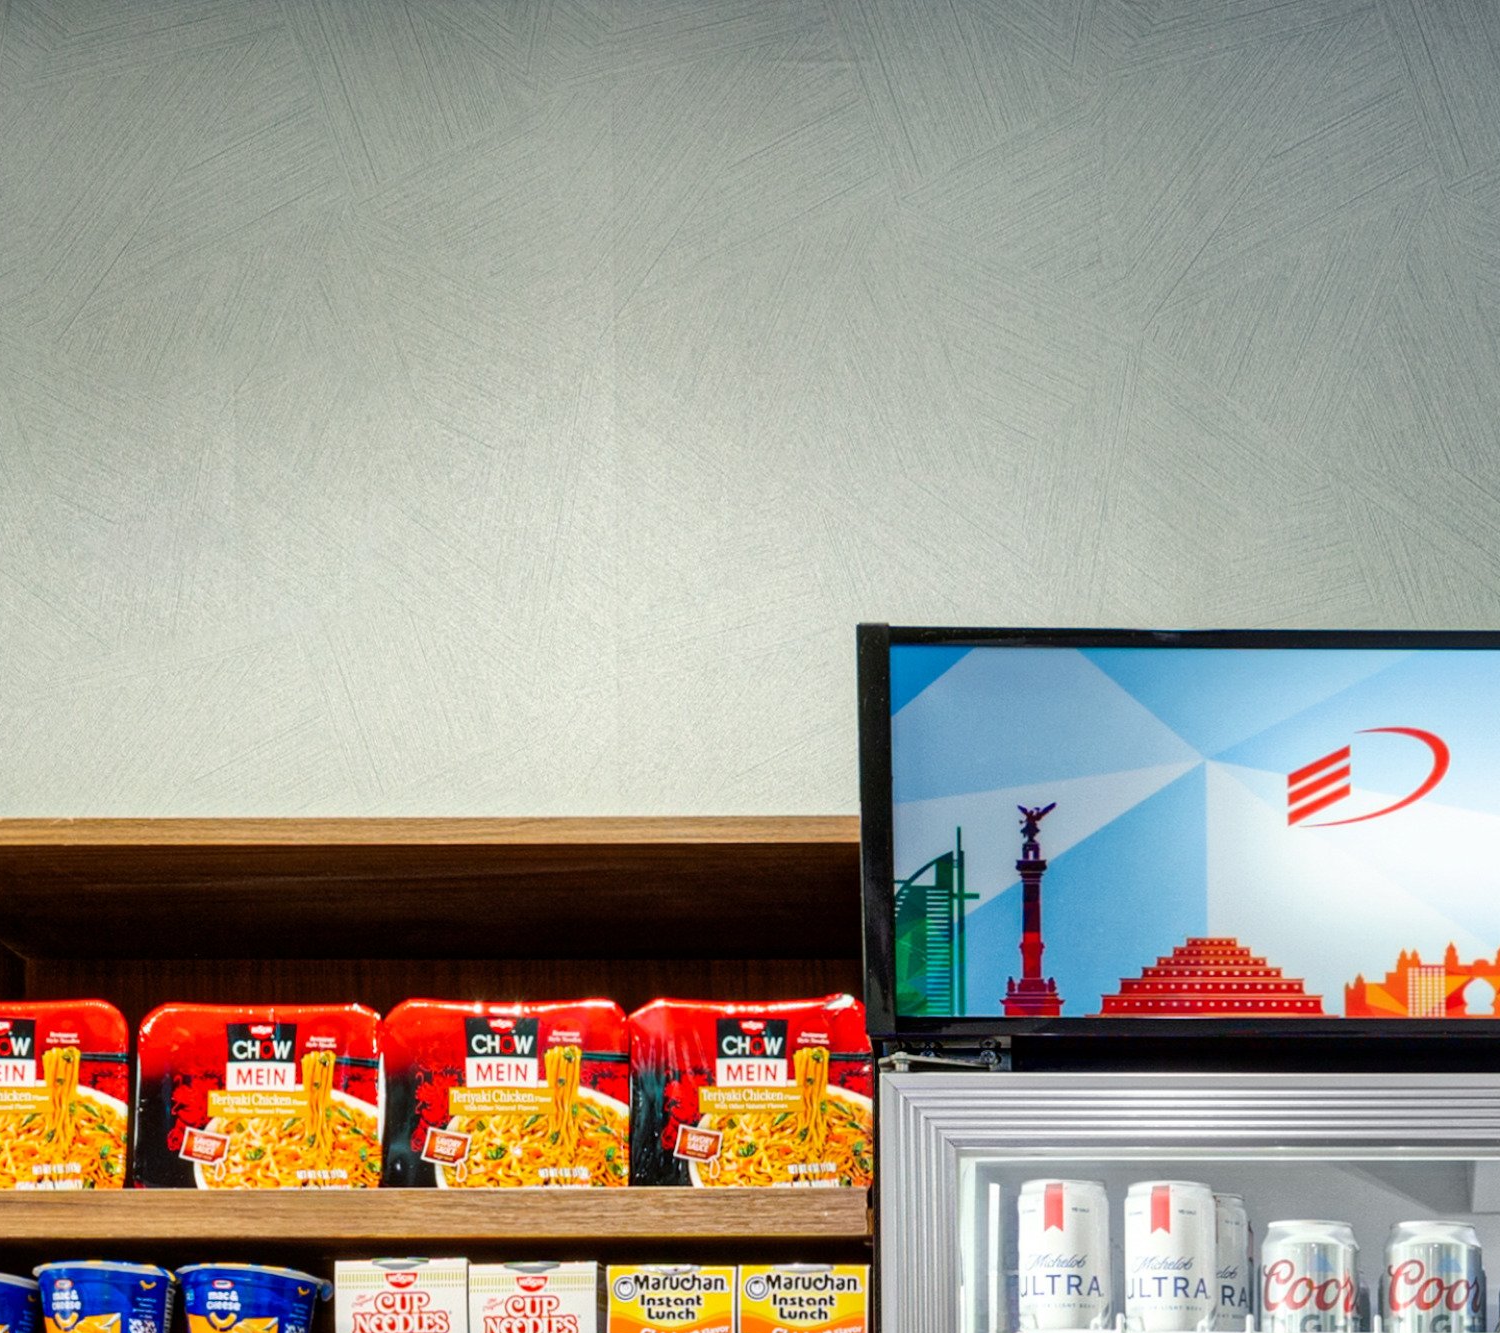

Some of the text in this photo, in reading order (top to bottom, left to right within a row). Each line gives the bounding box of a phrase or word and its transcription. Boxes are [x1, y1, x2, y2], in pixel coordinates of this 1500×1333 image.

[471, 1034, 534, 1056] CHOW
[475, 1063, 528, 1082] MEIN
[451, 1089, 534, 1104] Teriyaki Chicken
[1028, 1253, 1088, 1271] Michelob
[634, 1274, 725, 1291] Maruchan
[375, 1292, 430, 1314] CUP
[641, 1295, 702, 1307] Instant
[647, 1308, 695, 1320] Lunch
